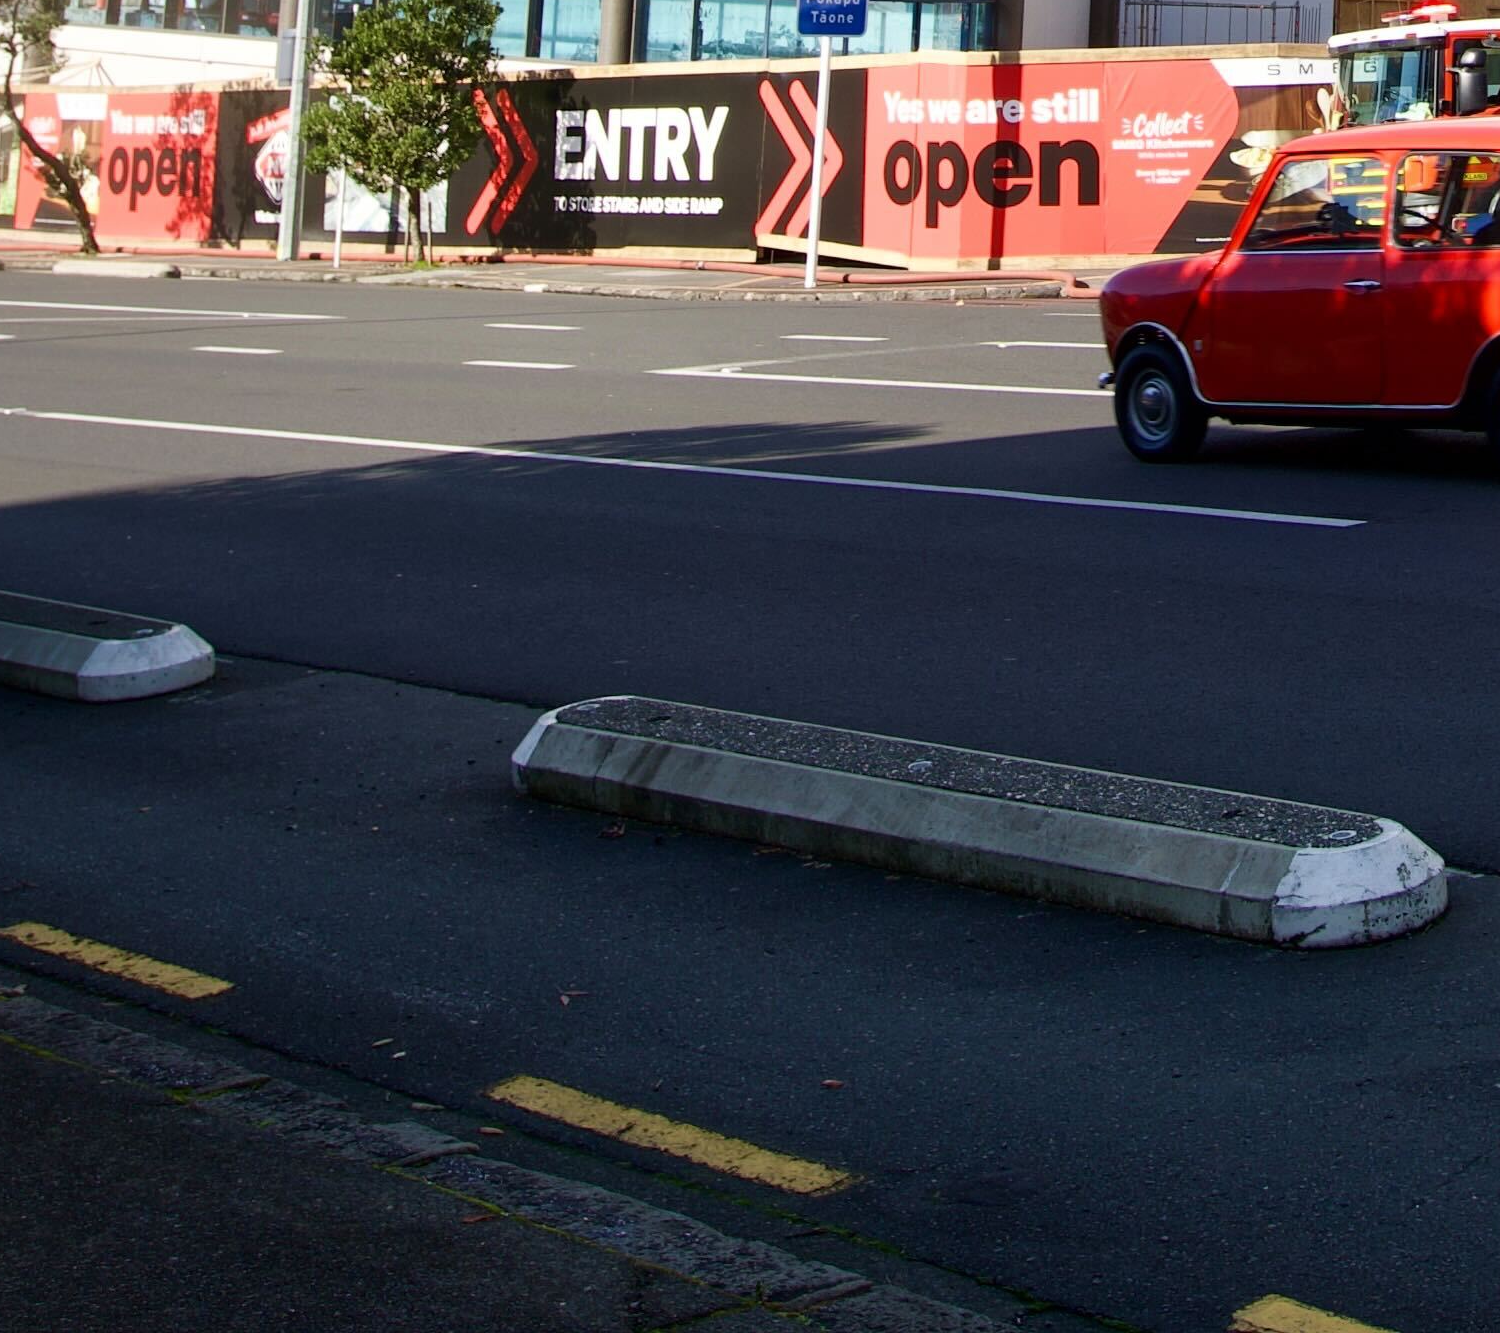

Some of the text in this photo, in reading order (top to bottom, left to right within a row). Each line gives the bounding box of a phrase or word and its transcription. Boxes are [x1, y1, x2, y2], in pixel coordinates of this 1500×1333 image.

[883, 88, 1100, 124] Yes we are still
[1132, 112, 1193, 138] Collect
[555, 106, 730, 181] ENTRY
[107, 146, 202, 212] open
[883, 139, 1100, 229] open
[553, 196, 568, 213] TO
[639, 197, 663, 215] AND
[663, 197, 690, 215] SIDE
[690, 197, 724, 215] RAMP
